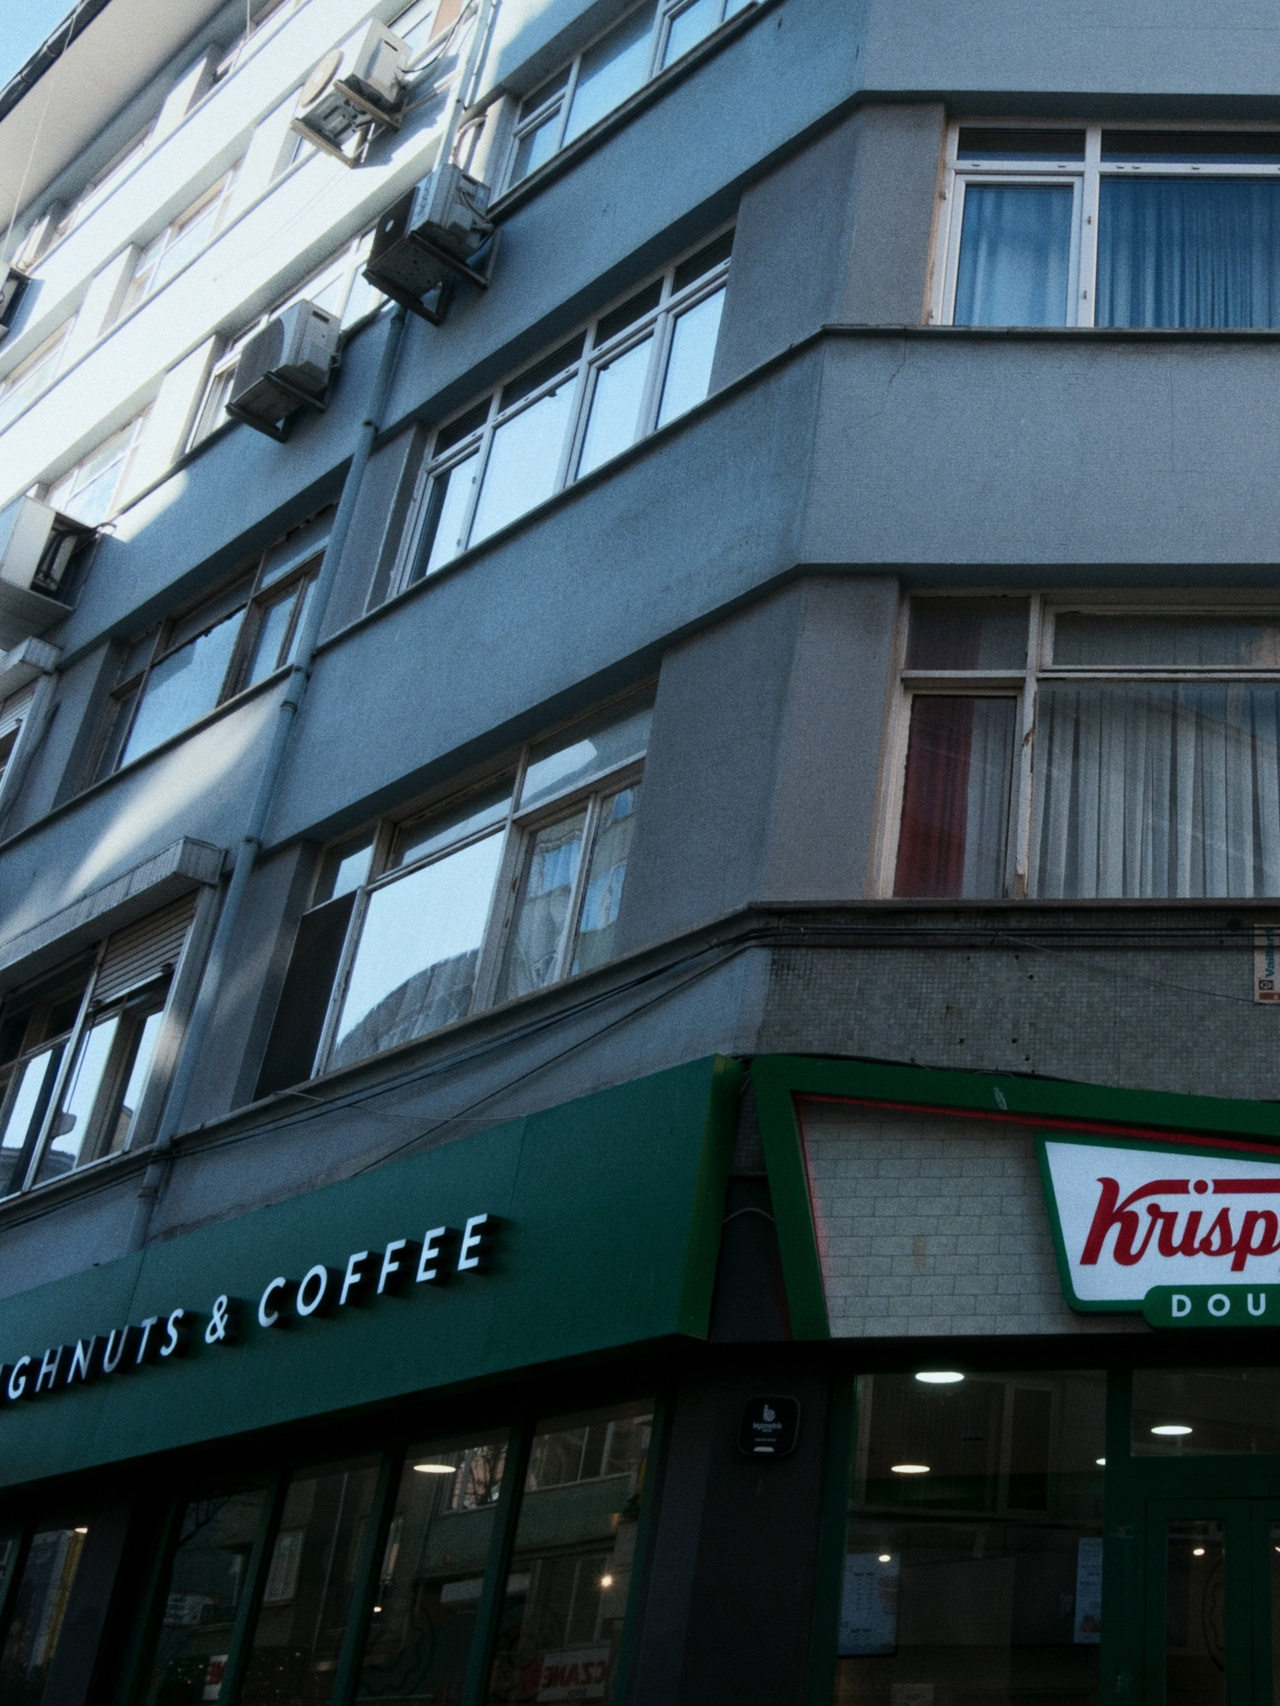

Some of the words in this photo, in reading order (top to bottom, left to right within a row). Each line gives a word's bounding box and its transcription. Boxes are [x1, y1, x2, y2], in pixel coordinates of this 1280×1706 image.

[0, 1307, 185, 1401] GHNUTS
[205, 1293, 229, 1344] &
[257, 1212, 489, 1328] COFFEE
